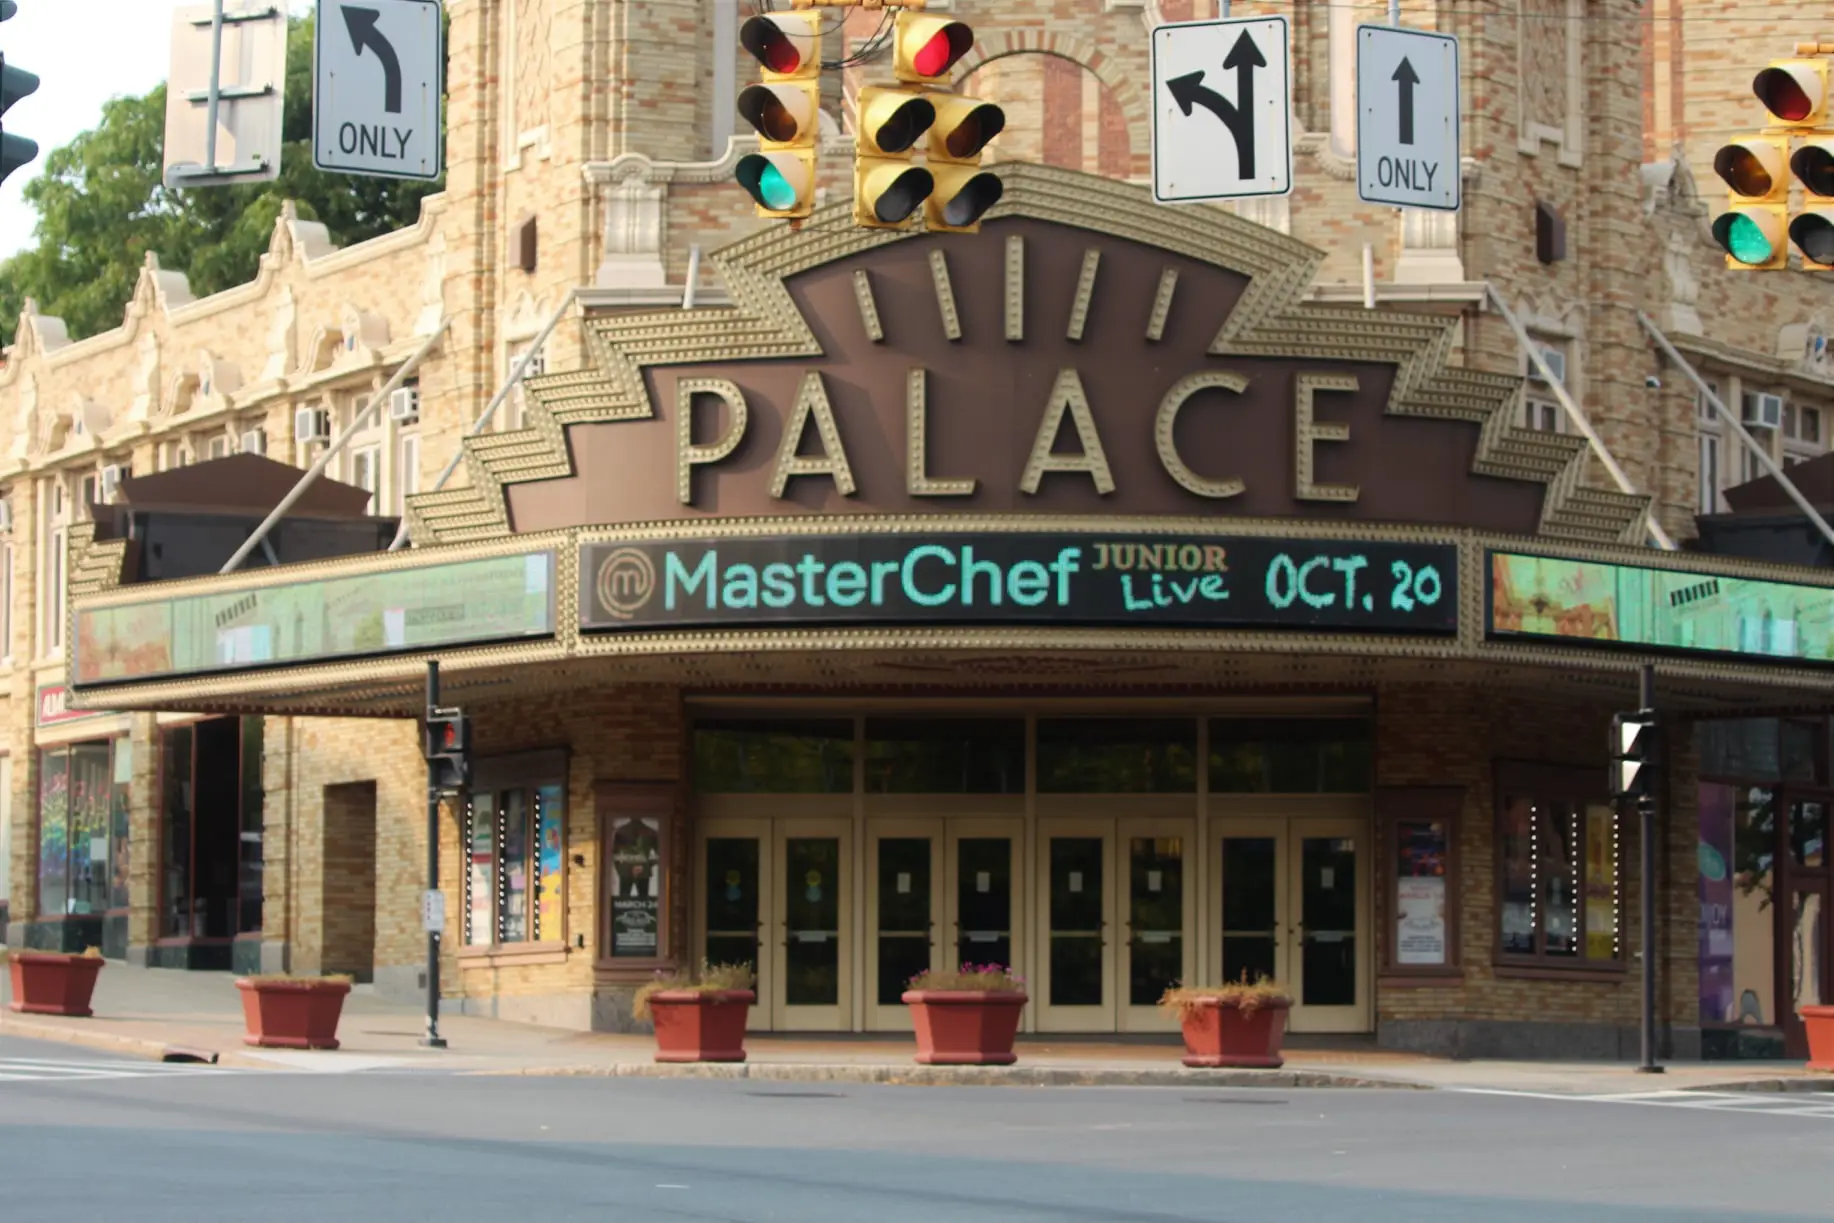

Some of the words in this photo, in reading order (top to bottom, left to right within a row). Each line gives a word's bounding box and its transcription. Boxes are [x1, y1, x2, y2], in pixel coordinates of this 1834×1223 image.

[339, 122, 413, 159] ONLY
[1378, 156, 1438, 192] ONLY
[677, 367, 1361, 503] PALACE
[1092, 543, 1230, 571] JUNIOR
[664, 544, 1082, 611] MasterChef
[1121, 573, 1230, 611] Live
[1265, 553, 1374, 612] OCT.
[1391, 560, 1442, 612] 20
